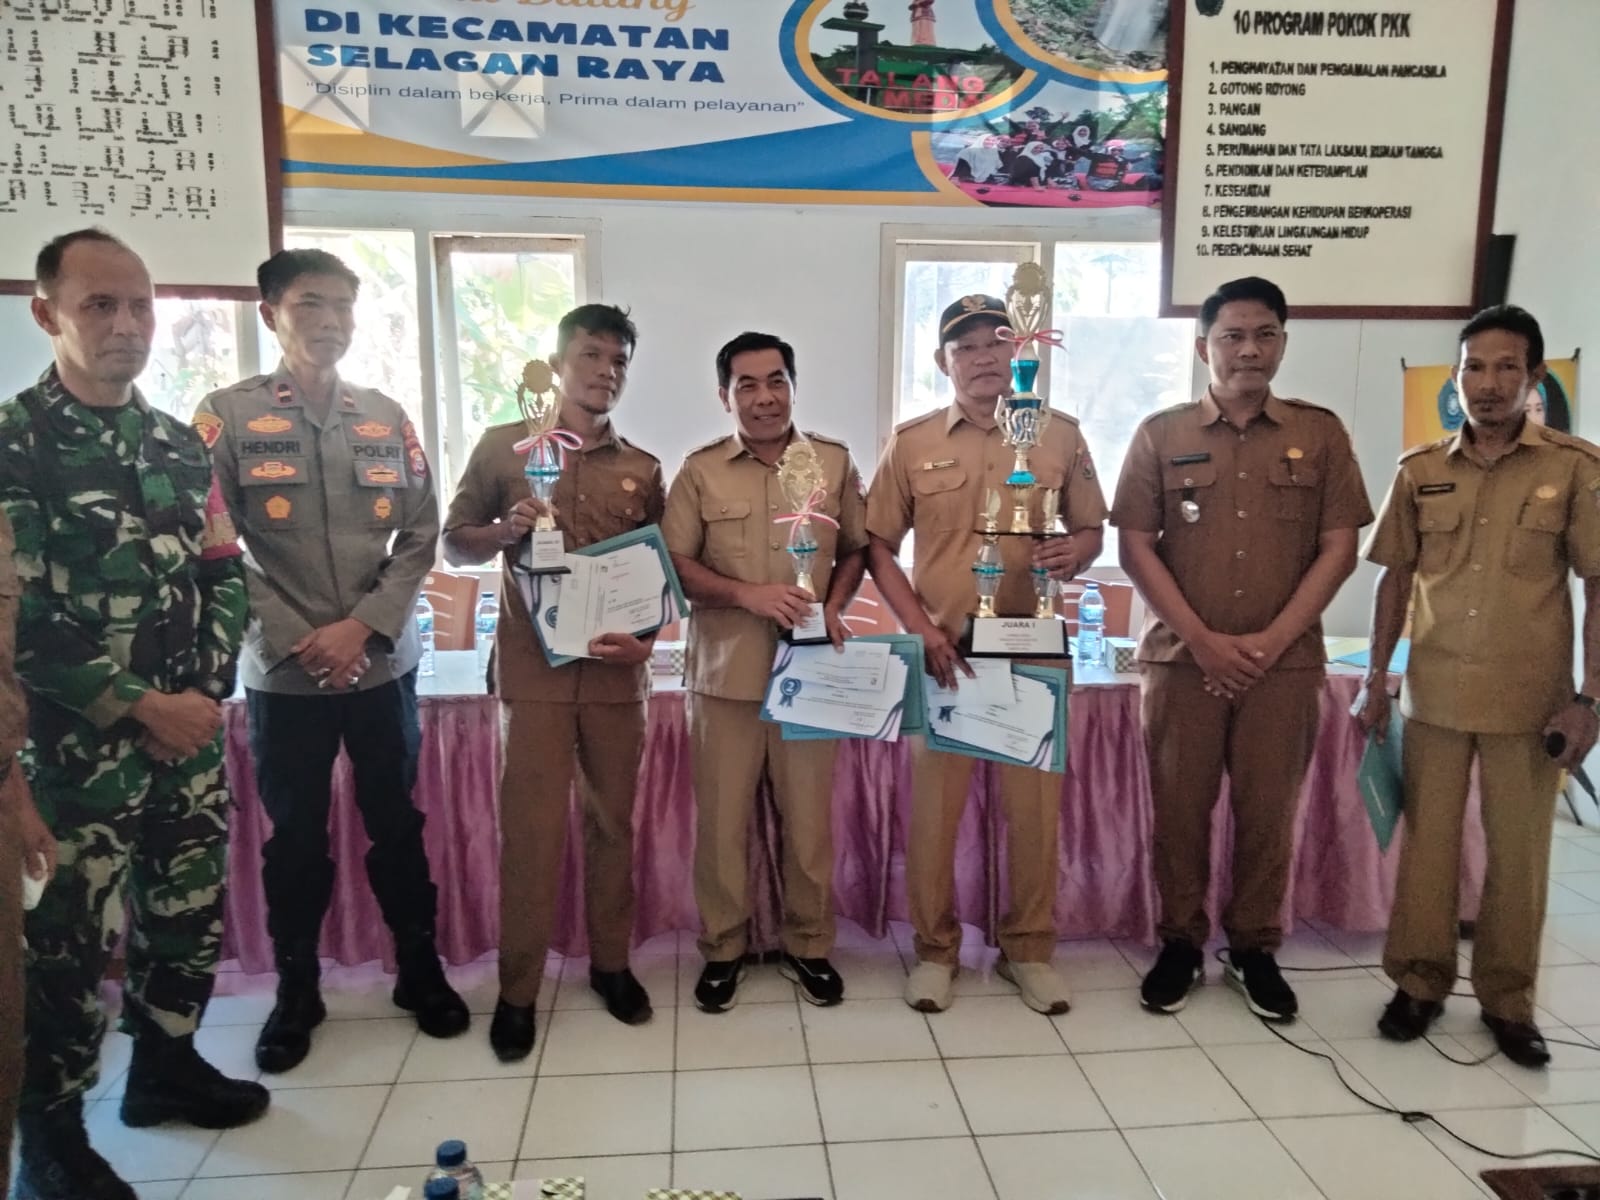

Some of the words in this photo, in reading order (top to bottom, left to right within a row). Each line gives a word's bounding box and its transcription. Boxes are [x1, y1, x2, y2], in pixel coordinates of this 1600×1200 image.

[304, 8, 360, 34] DI
[378, 12, 730, 51] KECAMATAN
[1233, 9, 1250, 34] 10
[1254, 11, 1324, 36] PROGRAM
[1327, 12, 1377, 37] POKOK
[1381, 13, 1411, 37] PKK
[307, 43, 559, 77] SELAGAN
[577, 55, 725, 83] RAYA
[1209, 61, 1218, 74] 1.
[1221, 61, 1294, 75] PENGHAYATAN
[1297, 63, 1318, 76] DAN
[1320, 63, 1389, 77] PENGAMALAN
[1208, 82, 1217, 95] 2.
[1220, 82, 1262, 95] GOTONG
[1265, 83, 1306, 96] ROYONG
[398, 85, 462, 100] dalam
[469, 87, 552, 105] bekerja,
[559, 92, 619, 107] Prima
[625, 96, 687, 110] dalam
[884, 90, 994, 110] MEDA
[1208, 103, 1216, 115] 3.
[1219, 103, 1261, 116] PANGAN
[1206, 123, 1215, 136] 4.
[1218, 123, 1266, 136] SANDANG
[1206, 144, 1214, 156] 5.
[1217, 143, 1276, 156] PERUMAHAN
[1278, 144, 1297, 156] DAN
[1299, 144, 1322, 157] TATA
[1205, 164, 1214, 176] 6.
[1275, 164, 1295, 177] DAN
[1296, 164, 1368, 178] KETERAMPILAN
[1204, 184, 1213, 197] 7.
[1215, 184, 1271, 197] KESEHATAN
[1213, 204, 1290, 218] PENGEMBANGAN
[1292, 206, 1346, 218] KEHIDUPAN
[1201, 225, 1210, 238] 9.
[1278, 226, 1339, 239] LINGKUNGAN
[1340, 226, 1370, 239] HIDUP
[1212, 243, 1280, 257] PERENCANAAN
[1282, 244, 1313, 257] SEHAT
[241, 441, 300, 454] HENDRI
[353, 445, 400, 459] POLRI
[785, 681, 796, 692] 2
